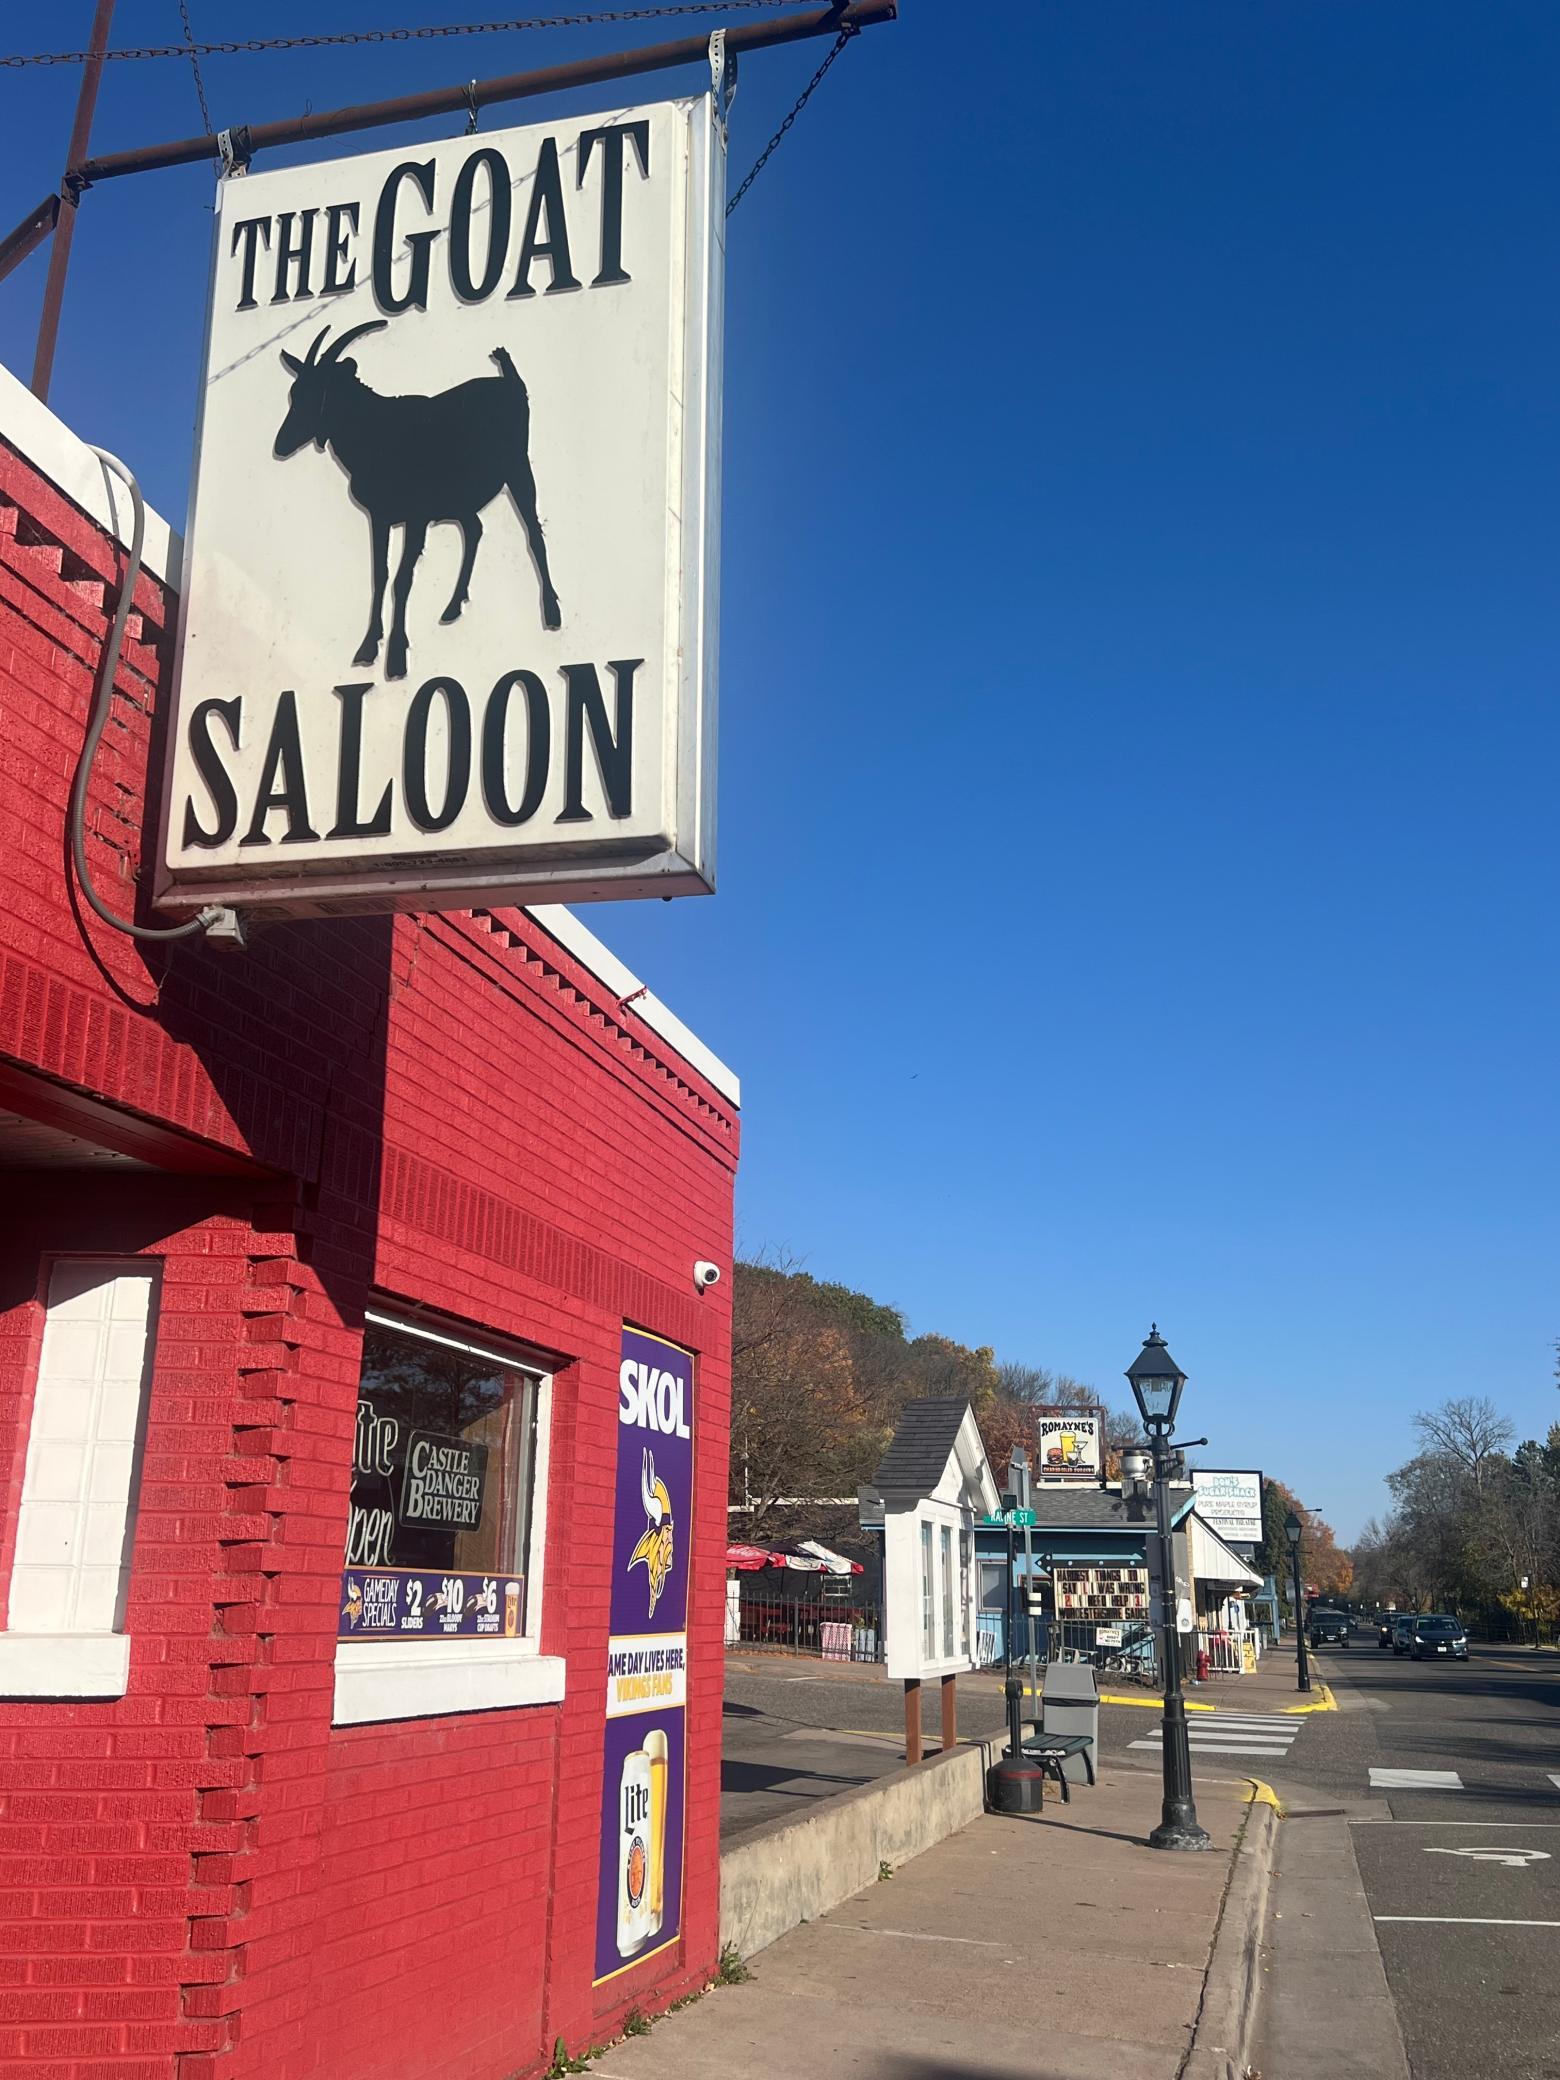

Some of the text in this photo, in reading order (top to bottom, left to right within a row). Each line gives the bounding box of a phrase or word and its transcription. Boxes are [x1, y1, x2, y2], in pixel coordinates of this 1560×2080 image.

[231, 120, 650, 315] THE GOAT
[182, 658, 645, 850] SALOON
[618, 1358, 691, 1440] SKOL
[1041, 1421, 1094, 1437] ROMAYNE'S
[412, 1440, 470, 1479] CASTLE
[424, 1470, 480, 1500] DANGER
[1197, 1486, 1257, 1498] SUGAR SHACK
[406, 1478, 480, 1524] BREWERY
[1019, 1512, 1029, 1524] ST
[1056, 1569, 1089, 1581] HARDEST
[1094, 1569, 1122, 1581] THINGS
[1062, 1582, 1078, 1594] SAY
[1097, 1582, 1115, 1594] WAS
[1118, 1582, 1145, 1594] WRONG
[363, 1576, 497, 1616] GAMEDAY $2 $10 $6
[1111, 1594, 1129, 1607] HELP
[362, 1603, 398, 1628] SPECIALS
[400, 1616, 424, 1629] SLIDERS
[1124, 1607, 1150, 1620] SAUCE
[608, 1653, 627, 1677] AME
[627, 1651, 644, 1675] DAY
[644, 1649, 665, 1673] LIVES
[616, 1671, 673, 1702] VIKINGS FANS
[624, 1783, 649, 1835] Lite
